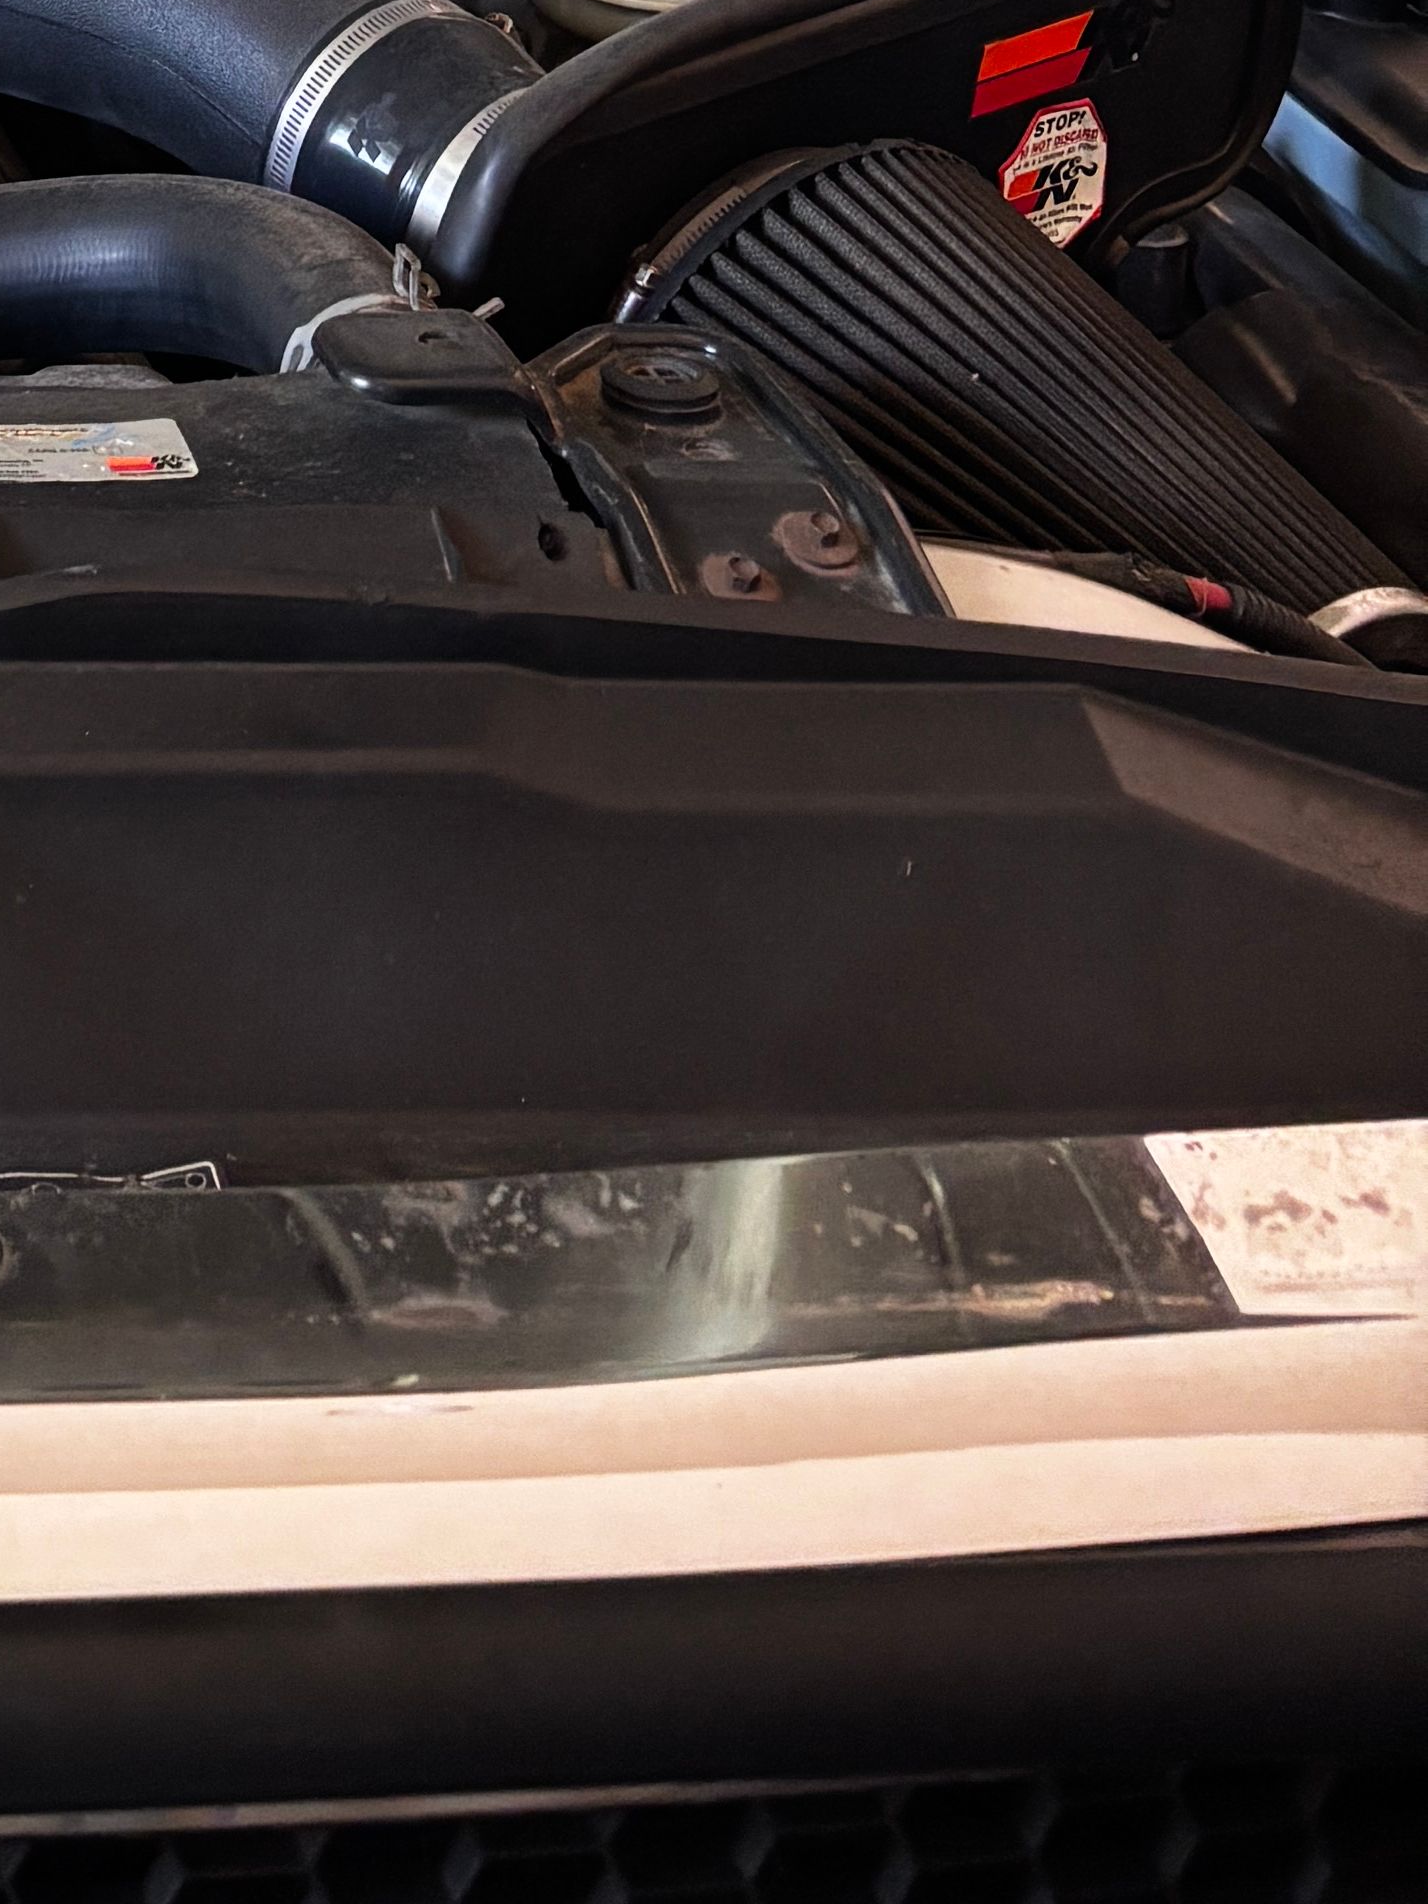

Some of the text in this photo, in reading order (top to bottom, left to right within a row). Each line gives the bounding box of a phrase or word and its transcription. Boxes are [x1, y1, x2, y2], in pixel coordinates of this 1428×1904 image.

[1034, 110, 1087, 138] STOP!
[1031, 137, 1052, 156] NOT
[1054, 128, 1099, 149] DISCARD
[1032, 156, 1099, 212] K&N
